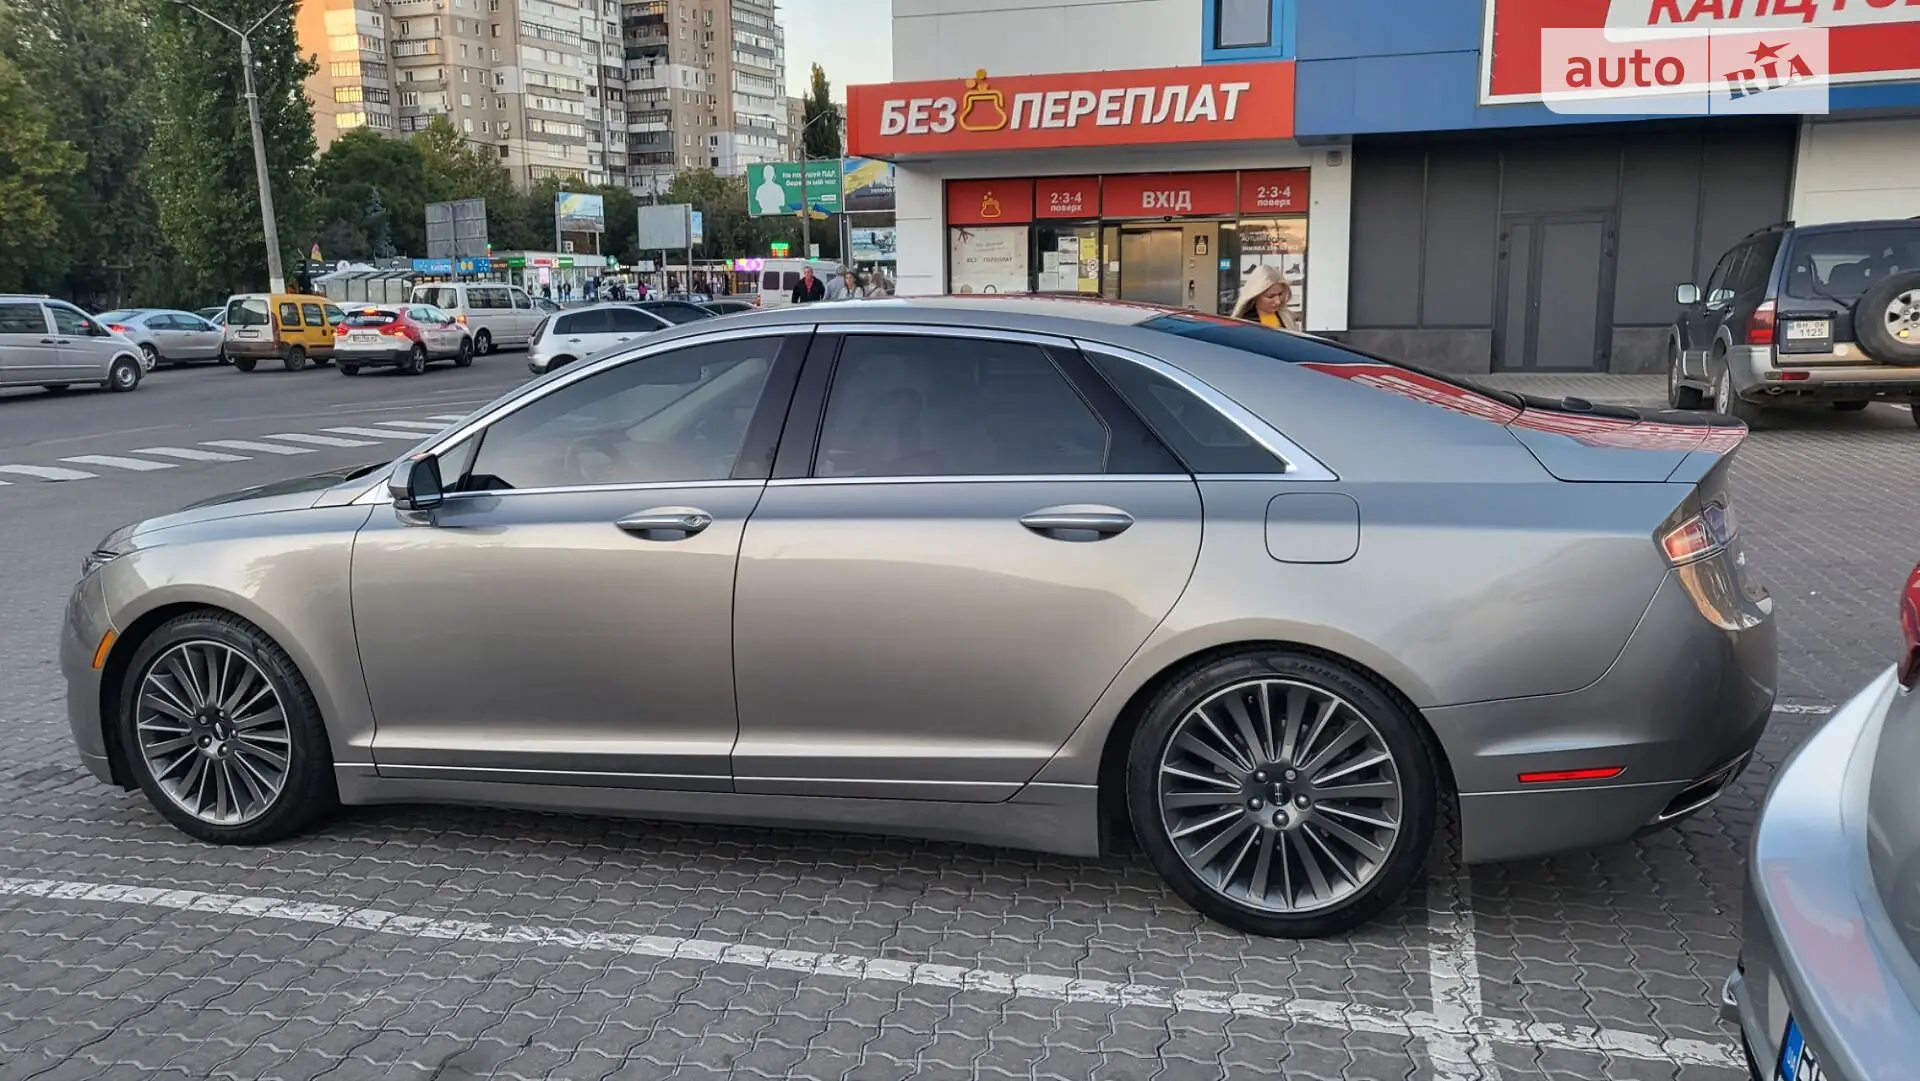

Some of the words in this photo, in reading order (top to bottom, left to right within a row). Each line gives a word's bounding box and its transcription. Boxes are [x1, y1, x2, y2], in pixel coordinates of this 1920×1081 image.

[880, 97, 957, 136] БЕЗ
[1010, 82, 1250, 130] ПЕРЕПЛАТ
[1142, 190, 1192, 211] ВХІД
[1257, 199, 1291, 207] поверх
[1051, 204, 1082, 213] поверх
[1800, 328, 1824, 337] 1125
